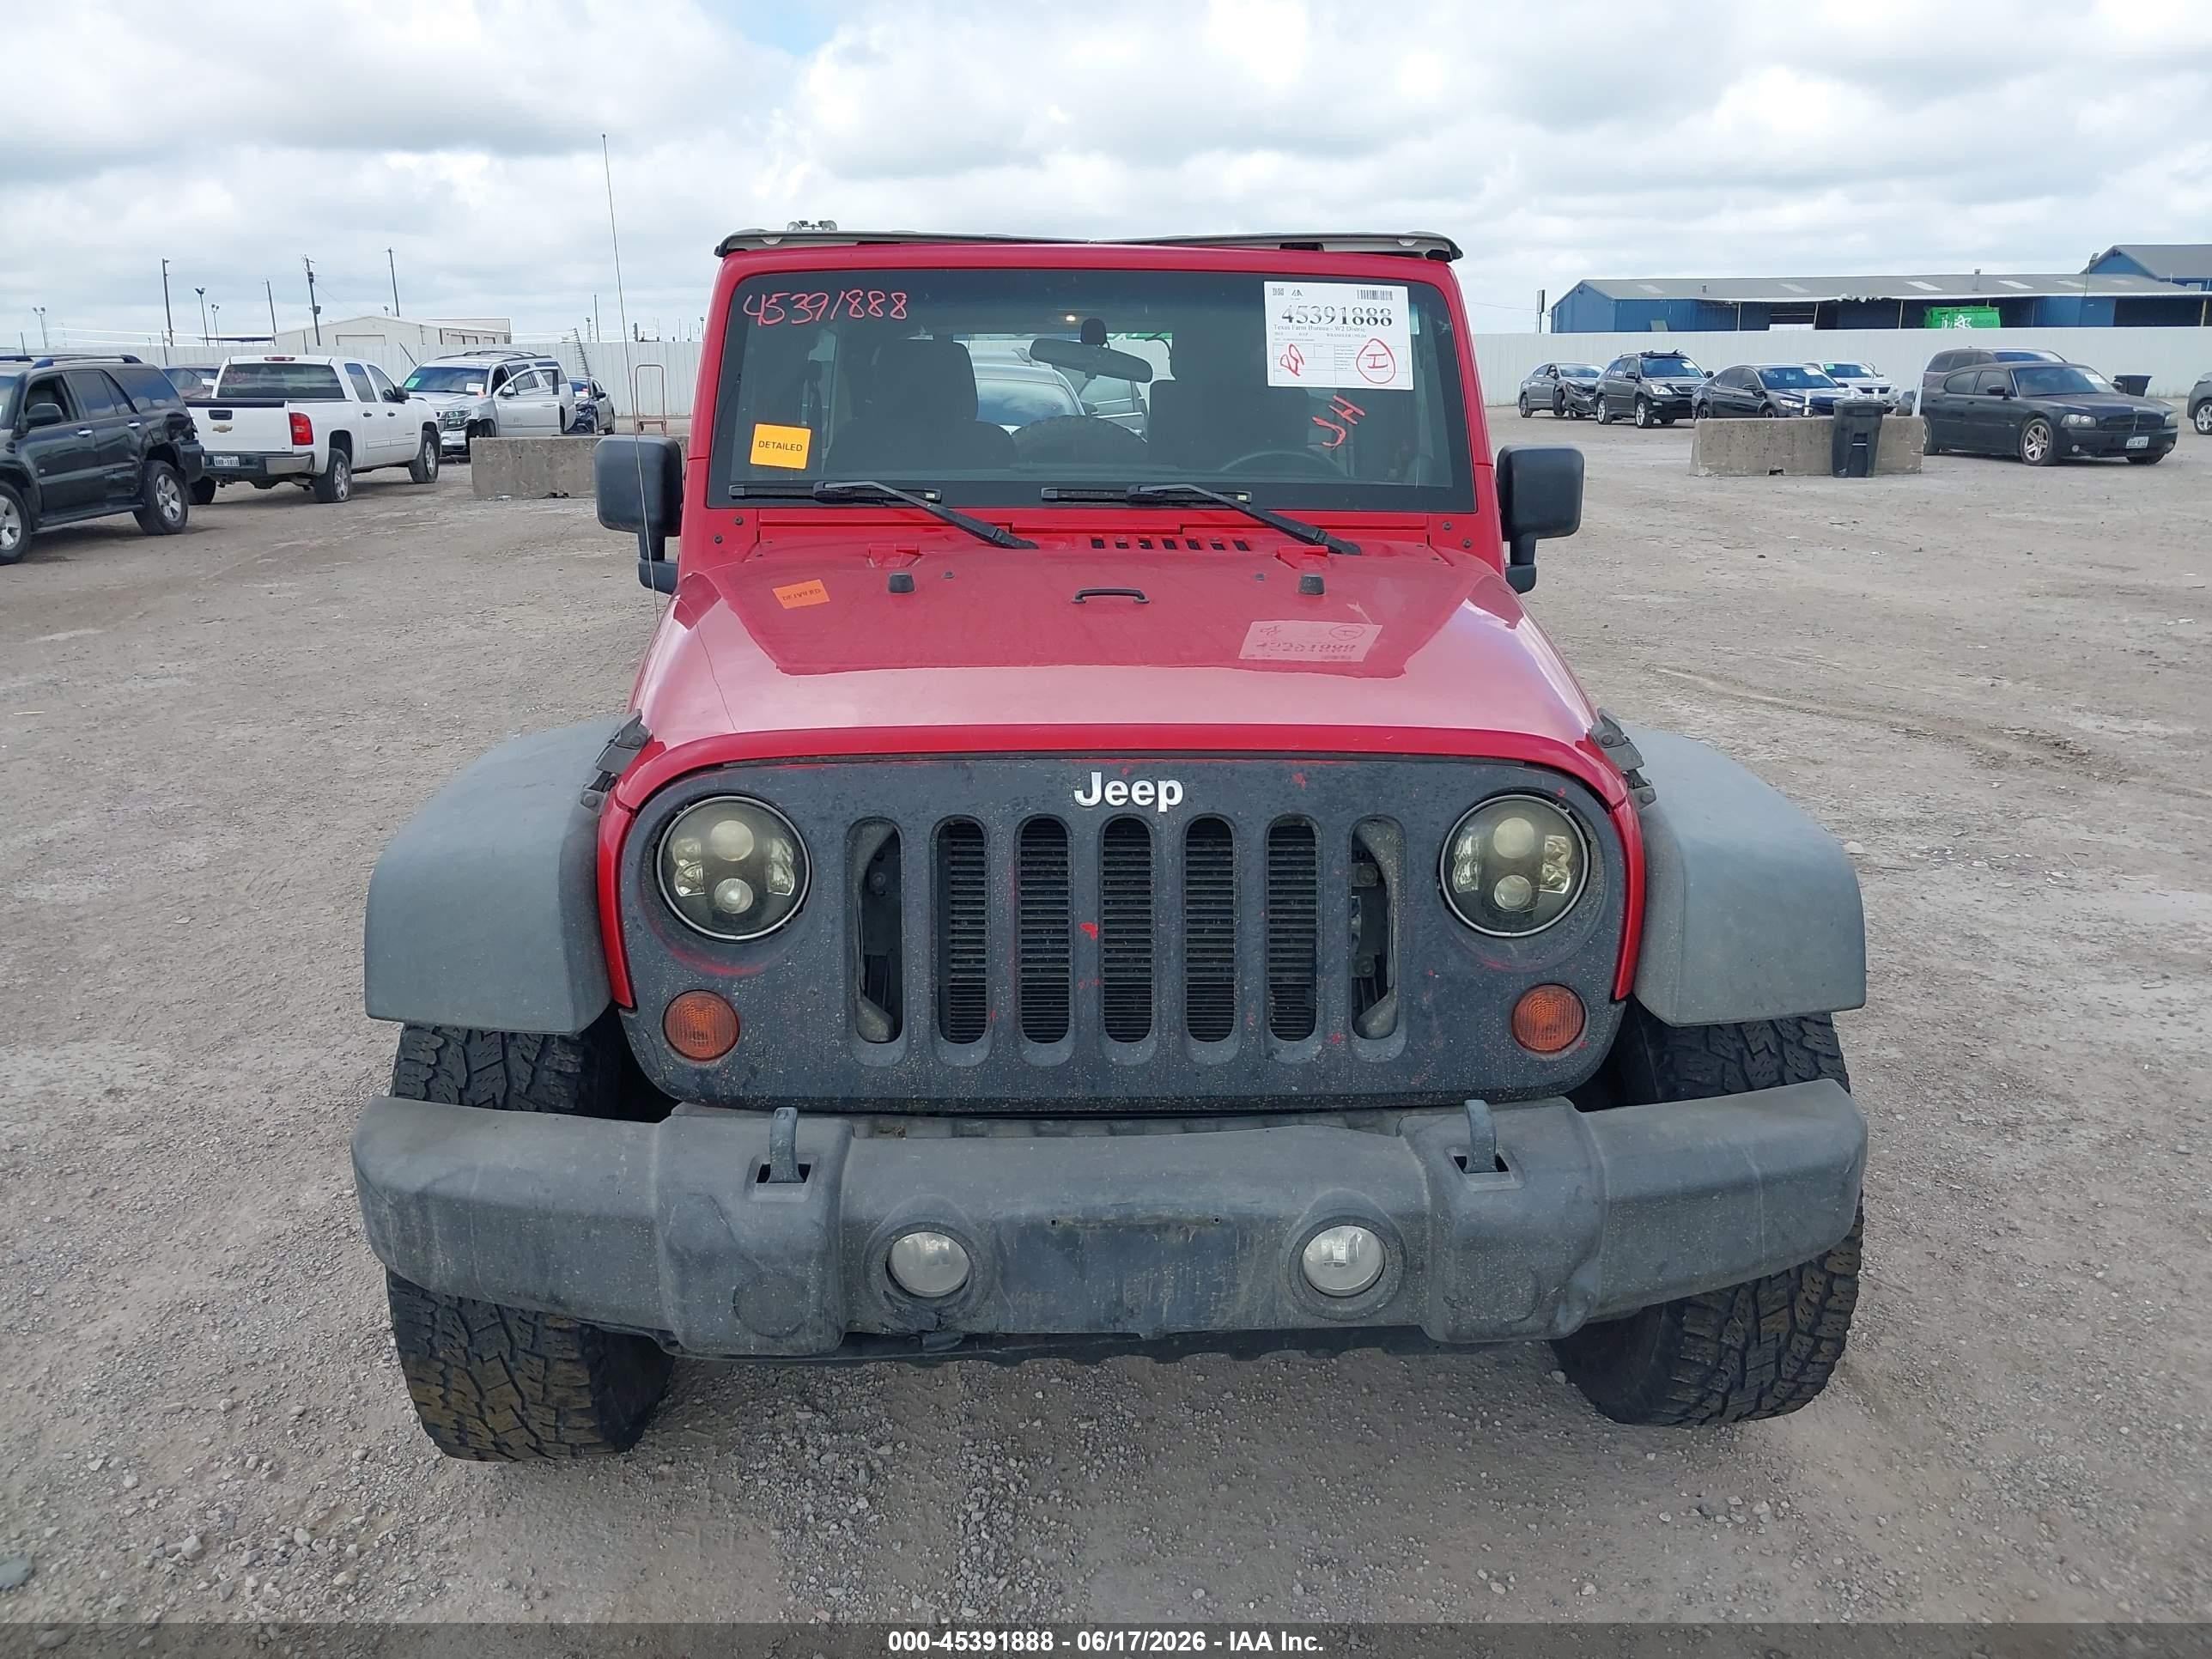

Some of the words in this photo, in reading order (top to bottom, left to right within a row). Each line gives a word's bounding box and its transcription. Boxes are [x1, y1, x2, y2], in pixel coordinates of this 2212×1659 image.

[743, 289, 908, 326] 45391888
[1281, 304, 1392, 326] 45391888
[758, 440, 803, 452] DETAILED
[1073, 771, 1184, 813] Jeep
